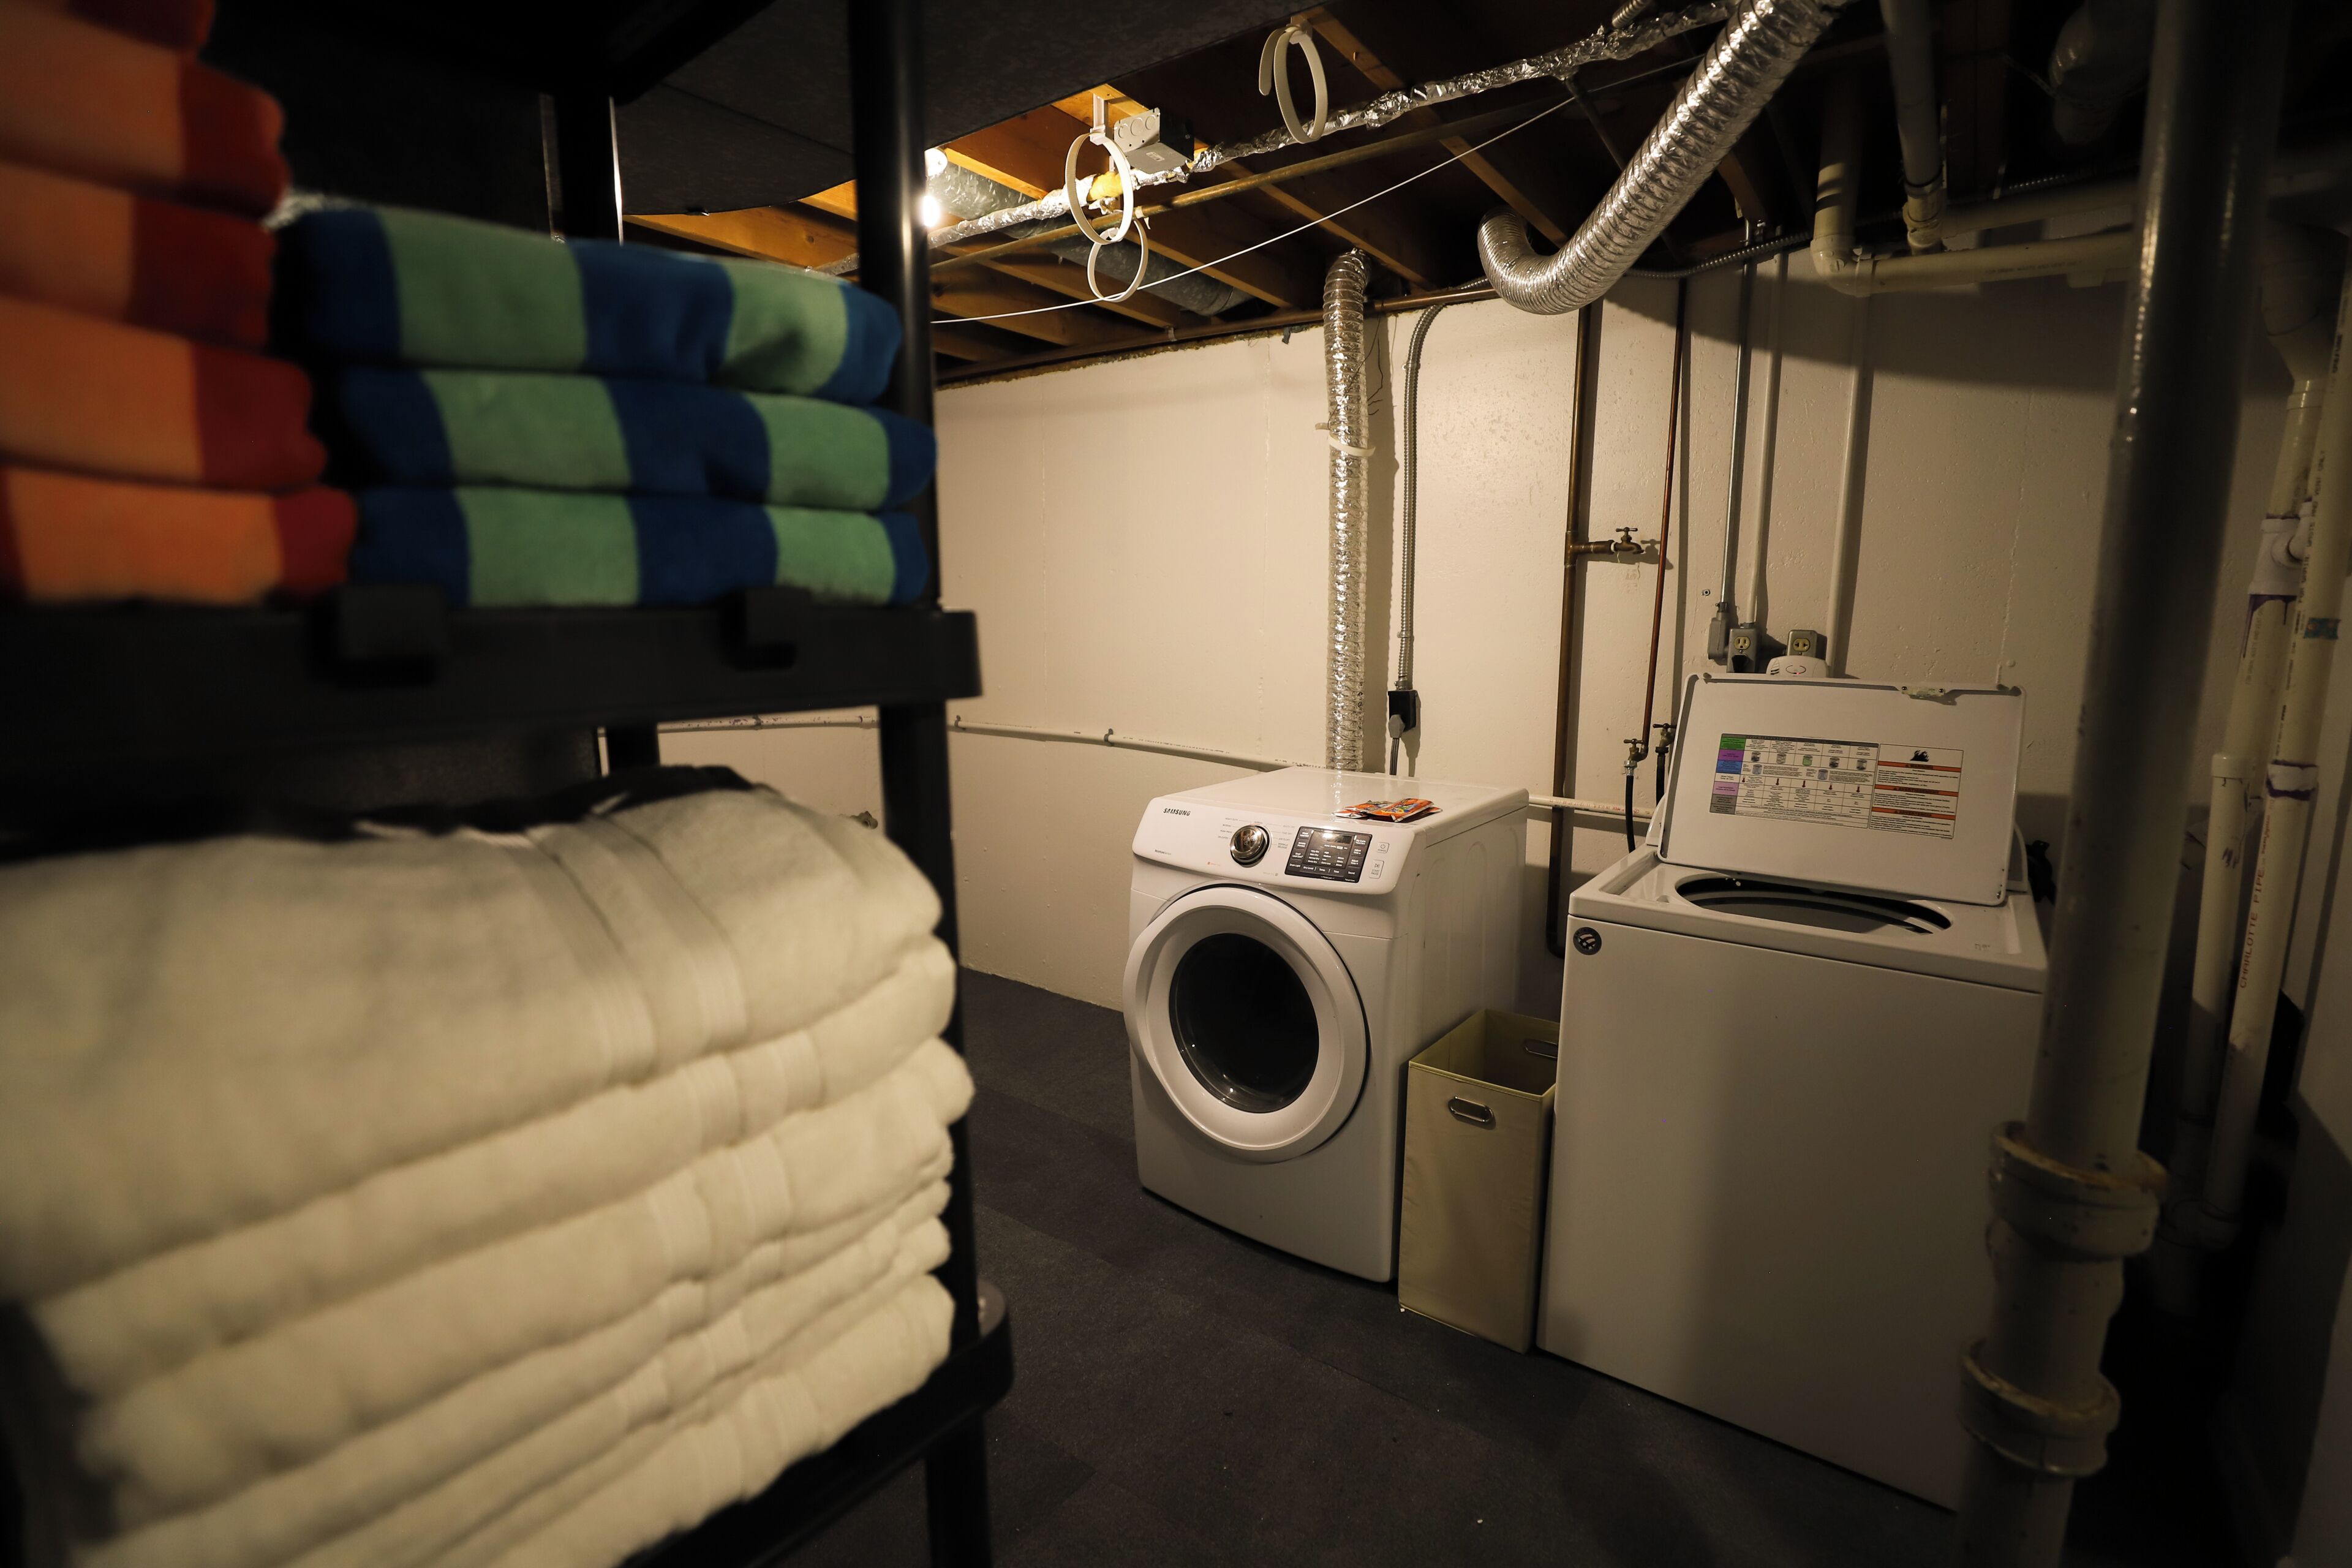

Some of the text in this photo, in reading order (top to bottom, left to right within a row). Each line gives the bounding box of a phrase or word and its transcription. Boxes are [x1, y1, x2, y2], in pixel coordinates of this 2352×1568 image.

[1163, 808, 1191, 816] SAMSUNG
[2239, 869, 2264, 989] CHARLOTTE PIPE
